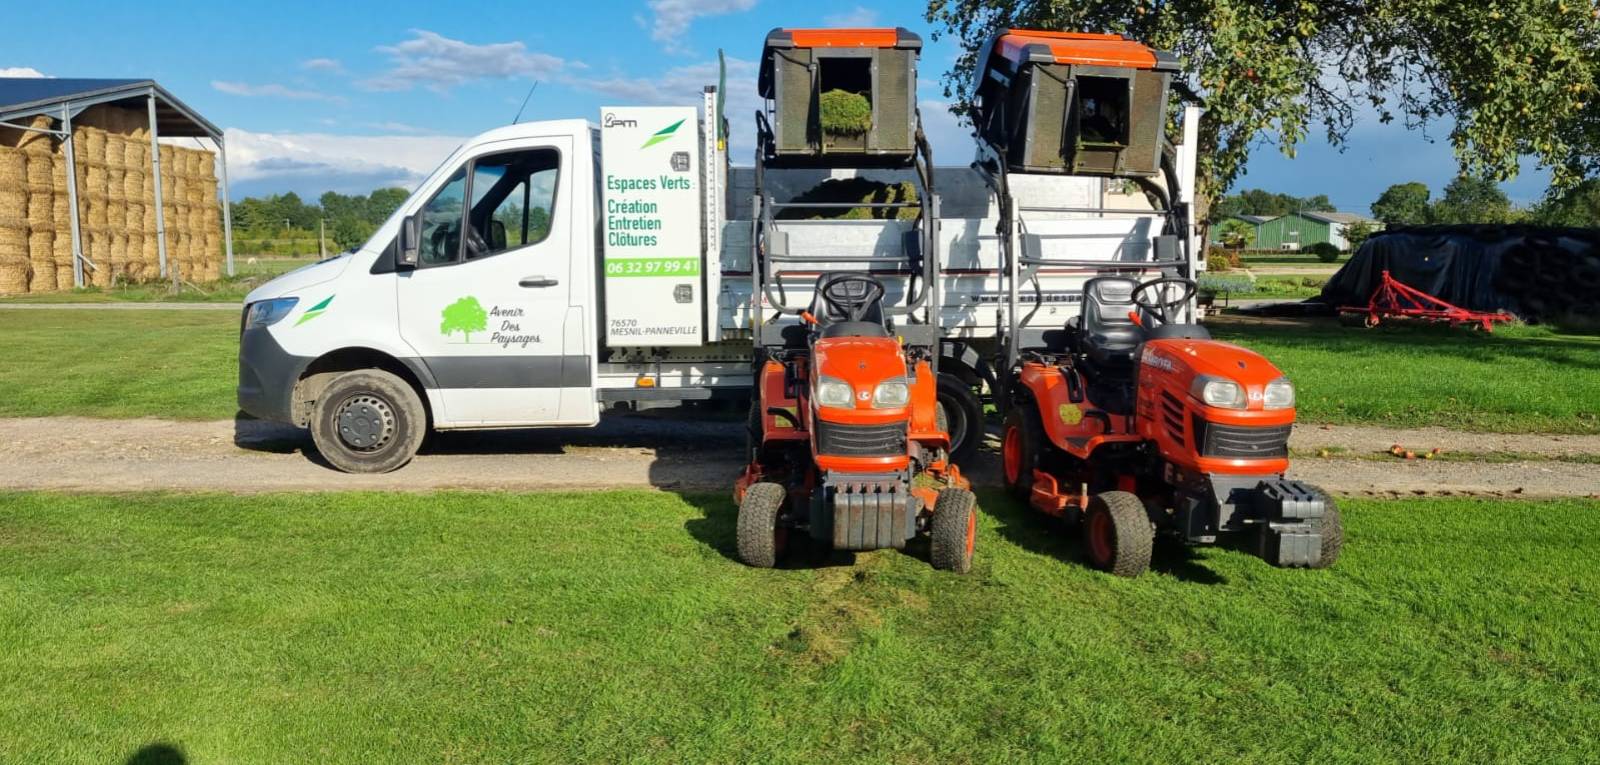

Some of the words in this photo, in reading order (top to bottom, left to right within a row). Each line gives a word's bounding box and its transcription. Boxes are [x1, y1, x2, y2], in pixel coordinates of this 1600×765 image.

[607, 175, 656, 193] Espaces
[660, 175, 690, 190] Verts
[607, 199, 657, 213] Création
[608, 215, 661, 230] Entretien
[608, 231, 657, 246] Clôtures
[607, 262, 623, 273] 06
[626, 262, 642, 273] 32
[646, 261, 661, 272] 97
[664, 261, 680, 272] 99
[683, 260, 698, 271] 41
[490, 305, 524, 317] Avenir
[501, 320, 520, 332] Des
[610, 319, 637, 327] 76570
[610, 326, 697, 336] MESNIL-PANNEVILLE
[490, 332, 541, 348] Paysages
